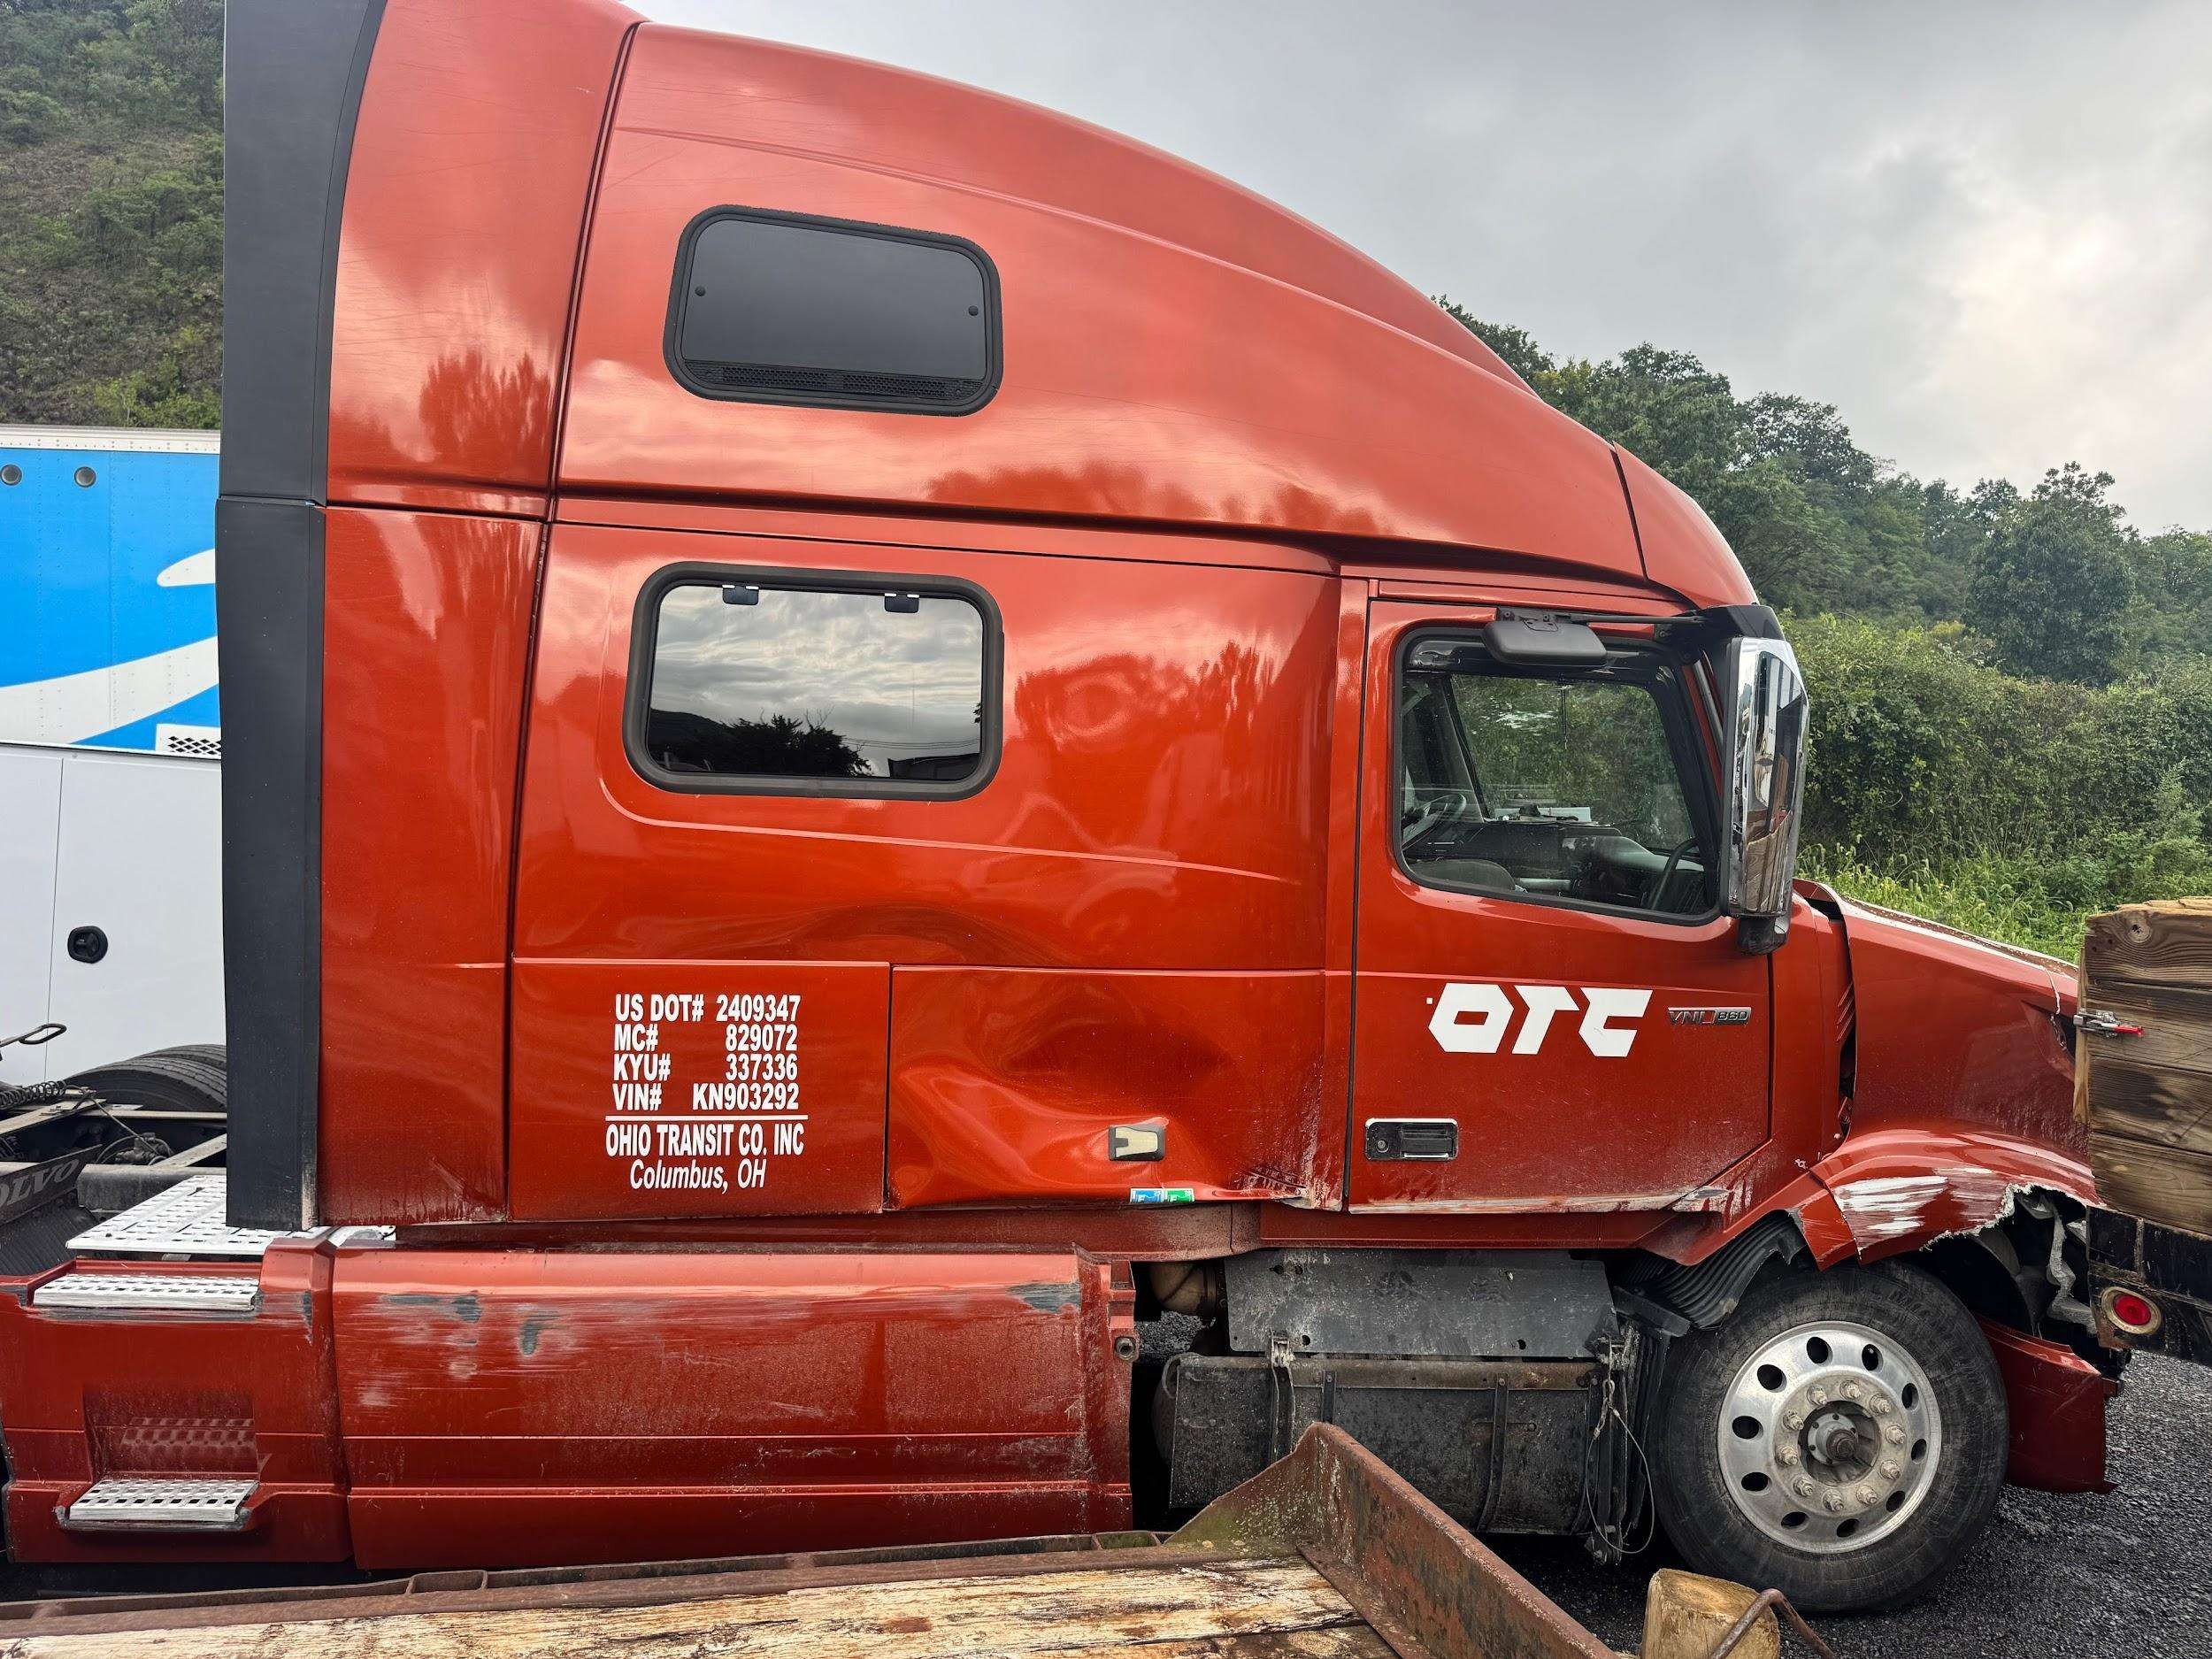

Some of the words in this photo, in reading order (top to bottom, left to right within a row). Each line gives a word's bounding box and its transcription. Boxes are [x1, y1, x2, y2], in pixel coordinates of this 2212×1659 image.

[615, 994, 644, 1022] US
[650, 994, 704, 1022] DOT#
[716, 994, 801, 1022] 2409347
[1426, 983, 1654, 1057] OTC
[614, 1024, 659, 1052] MC#
[725, 1024, 798, 1052] 829072
[613, 1053, 672, 1081] KYU#
[725, 1053, 798, 1081] 337336
[611, 1083, 663, 1111] VIN#
[692, 1083, 800, 1111] KN903292
[605, 1123, 651, 1157] OHIO
[656, 1123, 734, 1156] TRANSIT
[738, 1123, 767, 1156] CO.
[773, 1122, 804, 1156] INC
[629, 1158, 728, 1194] Columbus,
[737, 1157, 767, 1189] OH
